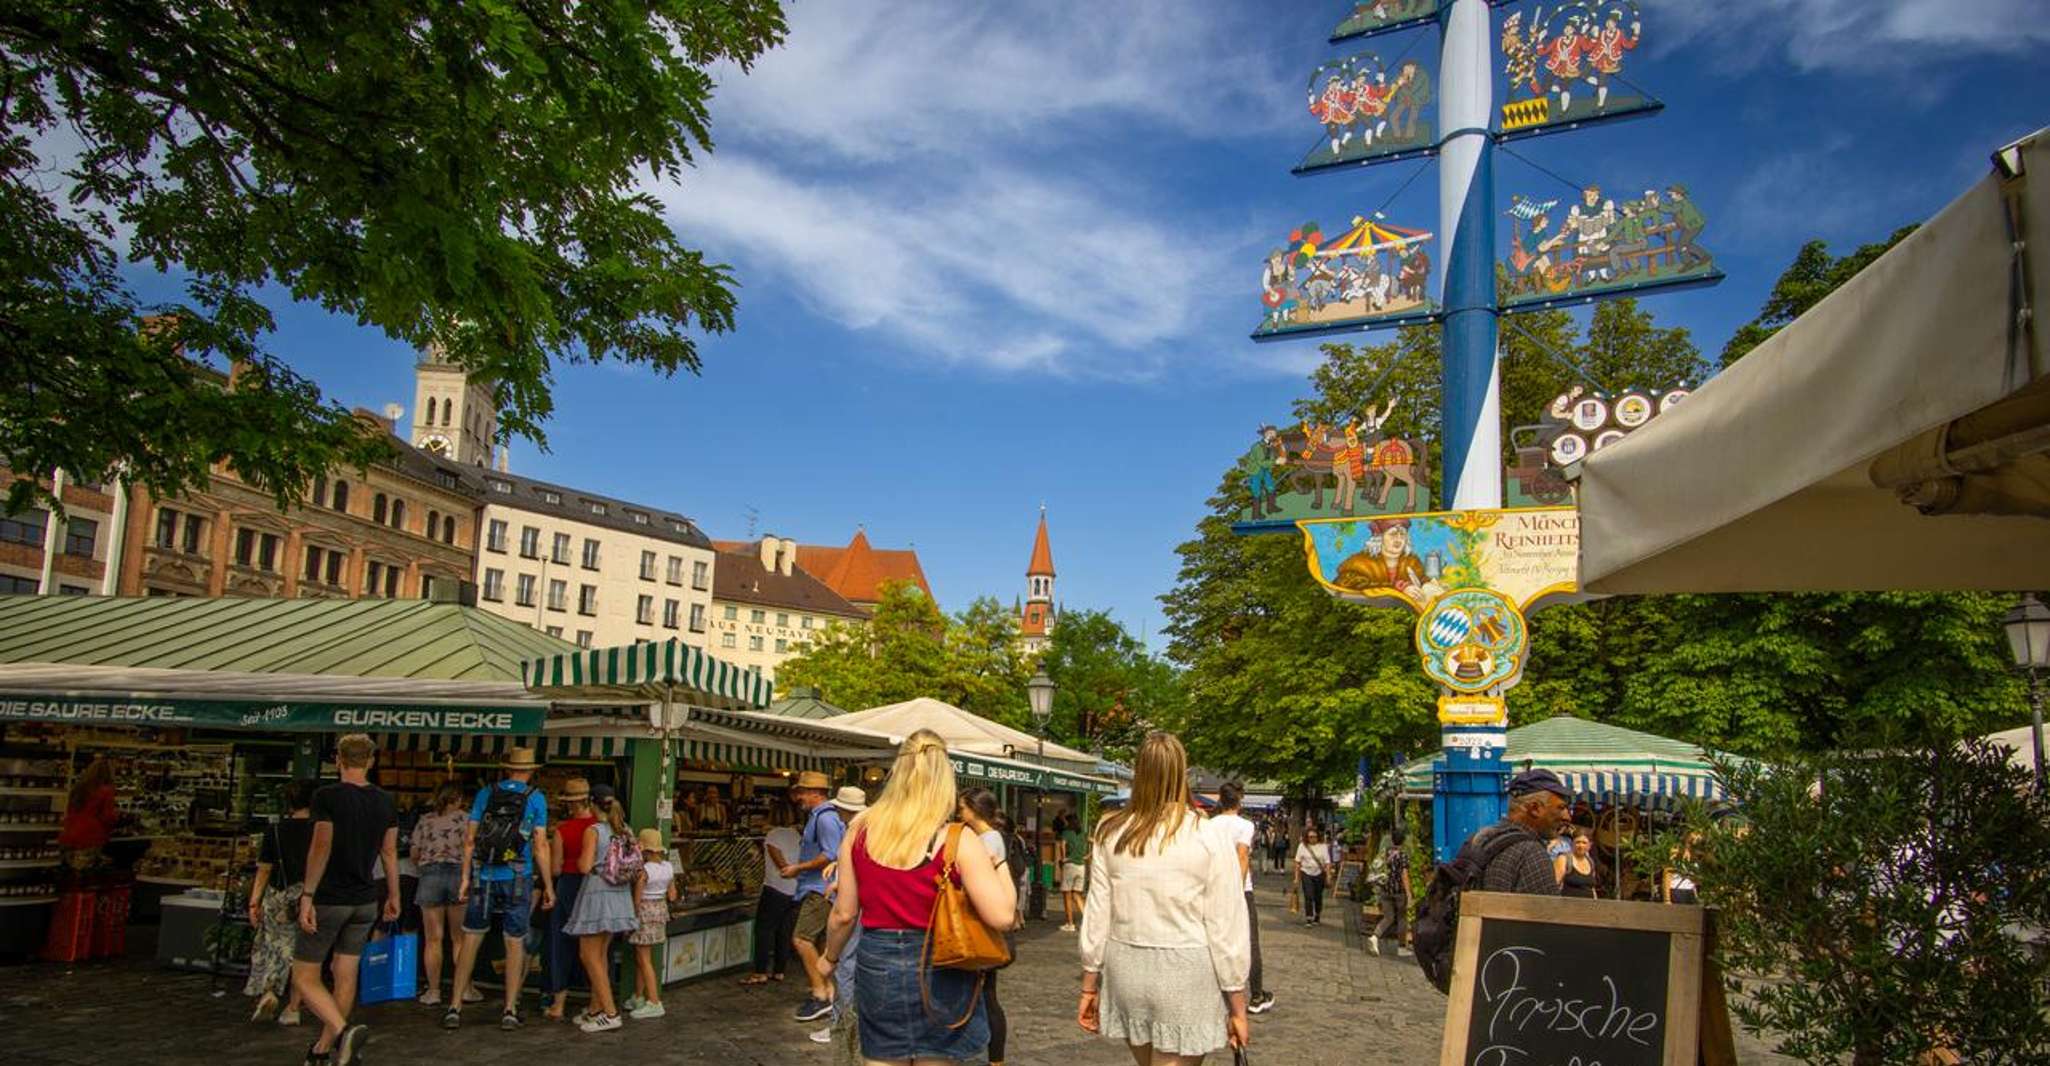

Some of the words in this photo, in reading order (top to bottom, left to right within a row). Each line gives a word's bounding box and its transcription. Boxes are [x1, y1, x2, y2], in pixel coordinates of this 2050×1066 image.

[29, 702, 108, 719] SAURE
[333, 709, 441, 727] GURKEN
[444, 712, 513, 729] ECKE
[1481, 945, 1658, 1046] Frische
